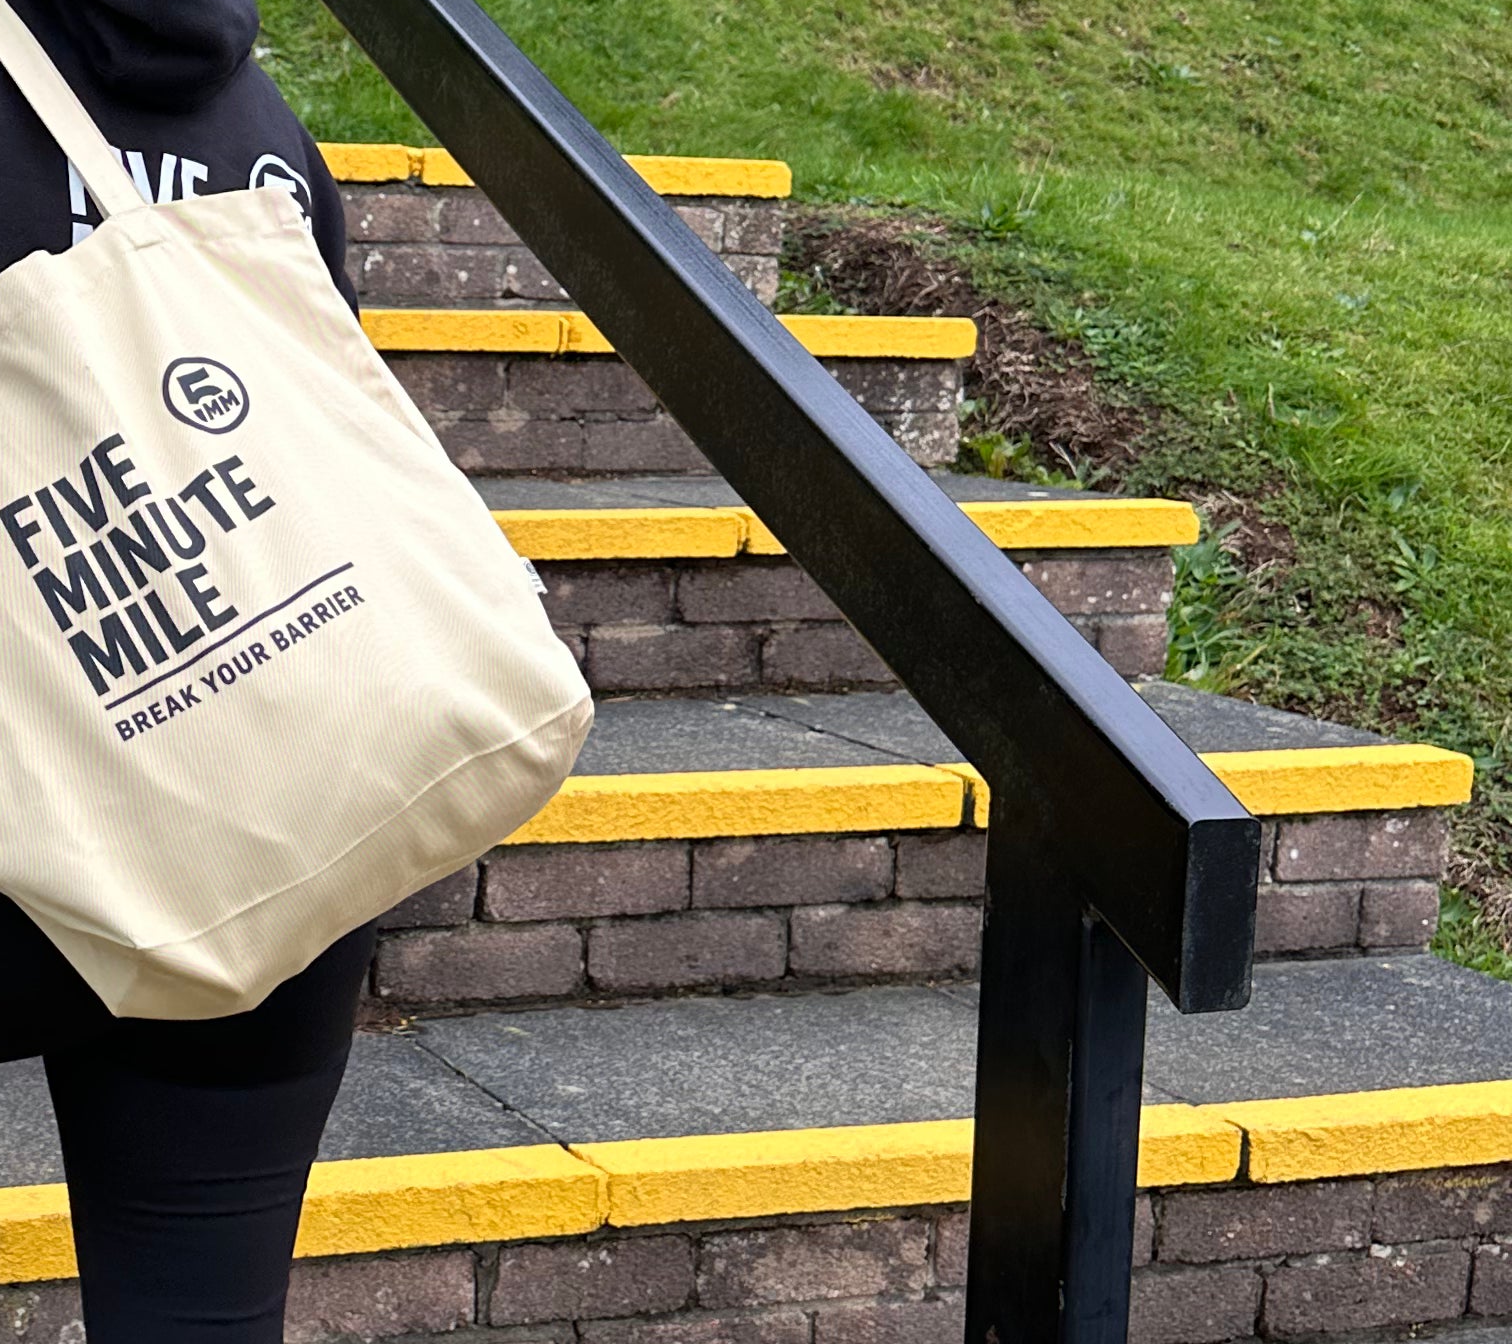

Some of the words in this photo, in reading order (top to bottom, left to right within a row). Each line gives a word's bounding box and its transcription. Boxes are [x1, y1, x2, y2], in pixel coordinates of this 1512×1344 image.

[32, 454, 277, 633] MINUTE
[66, 562, 240, 697] MILE
[114, 684, 202, 742] BREAK
[198, 642, 272, 694] YOUR
[269, 585, 365, 652] BARRIER
